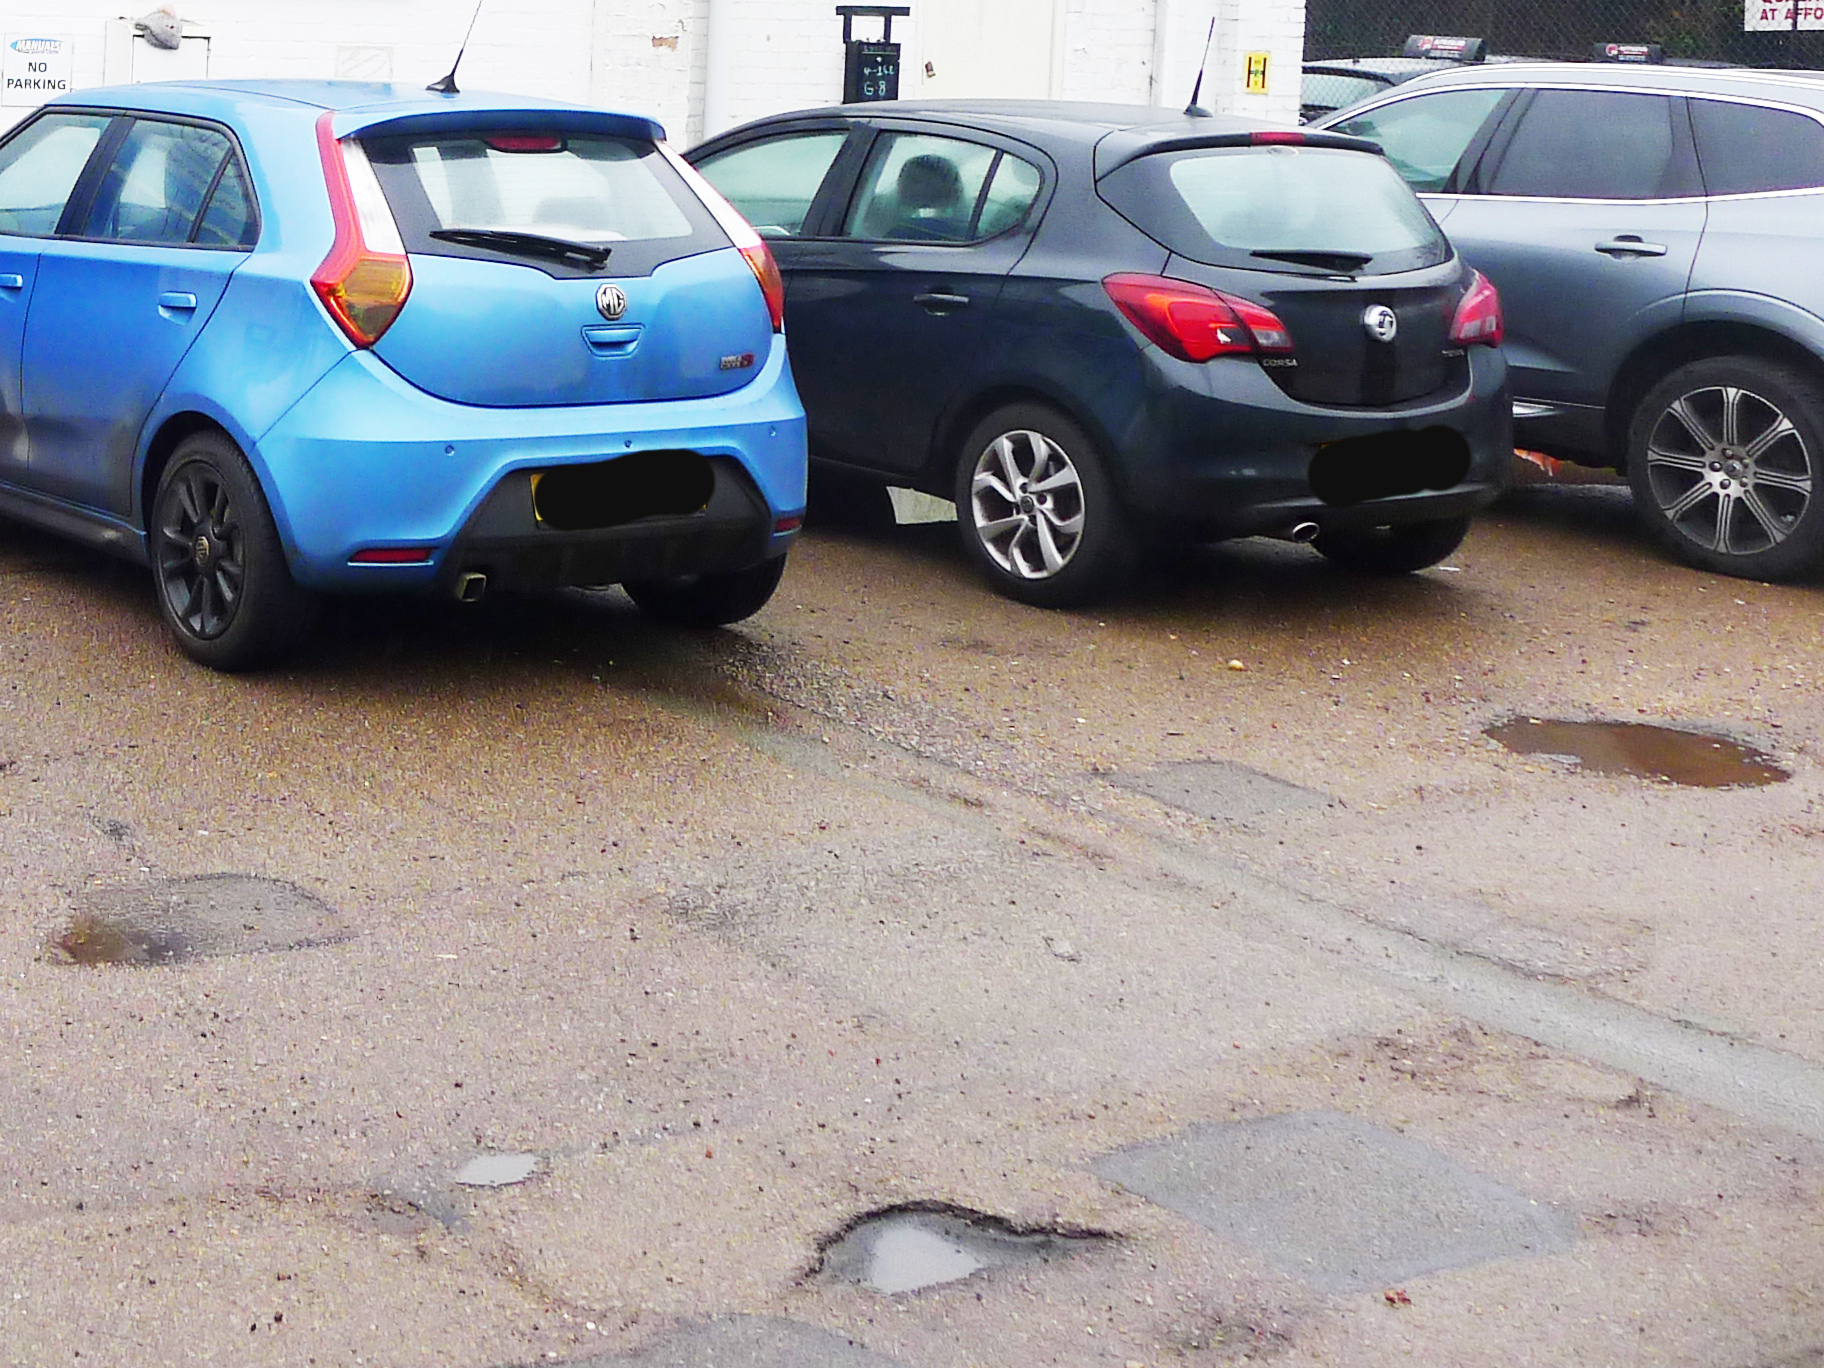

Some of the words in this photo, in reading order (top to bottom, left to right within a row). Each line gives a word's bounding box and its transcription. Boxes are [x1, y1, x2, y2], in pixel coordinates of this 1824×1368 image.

[1759, 8, 1778, 21] AT
[27, 61, 47, 73] NO
[7, 78, 66, 90] PARKING
[601, 287, 625, 315] MG
